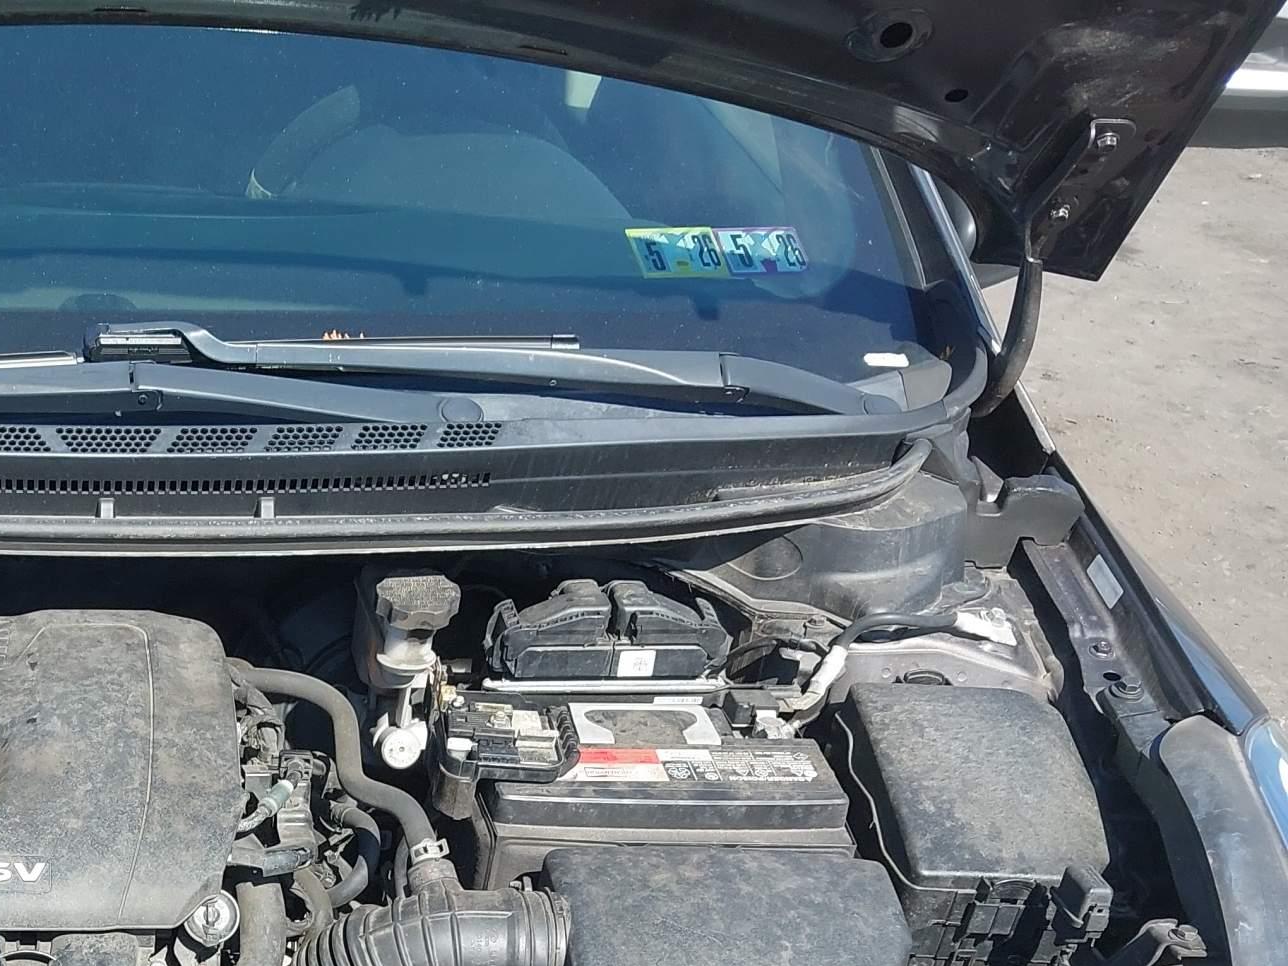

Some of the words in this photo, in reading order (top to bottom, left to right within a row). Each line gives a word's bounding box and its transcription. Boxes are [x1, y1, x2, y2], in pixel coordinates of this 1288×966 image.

[646, 242, 666, 271] 5
[692, 234, 721, 268] 26
[732, 234, 755, 268] 5
